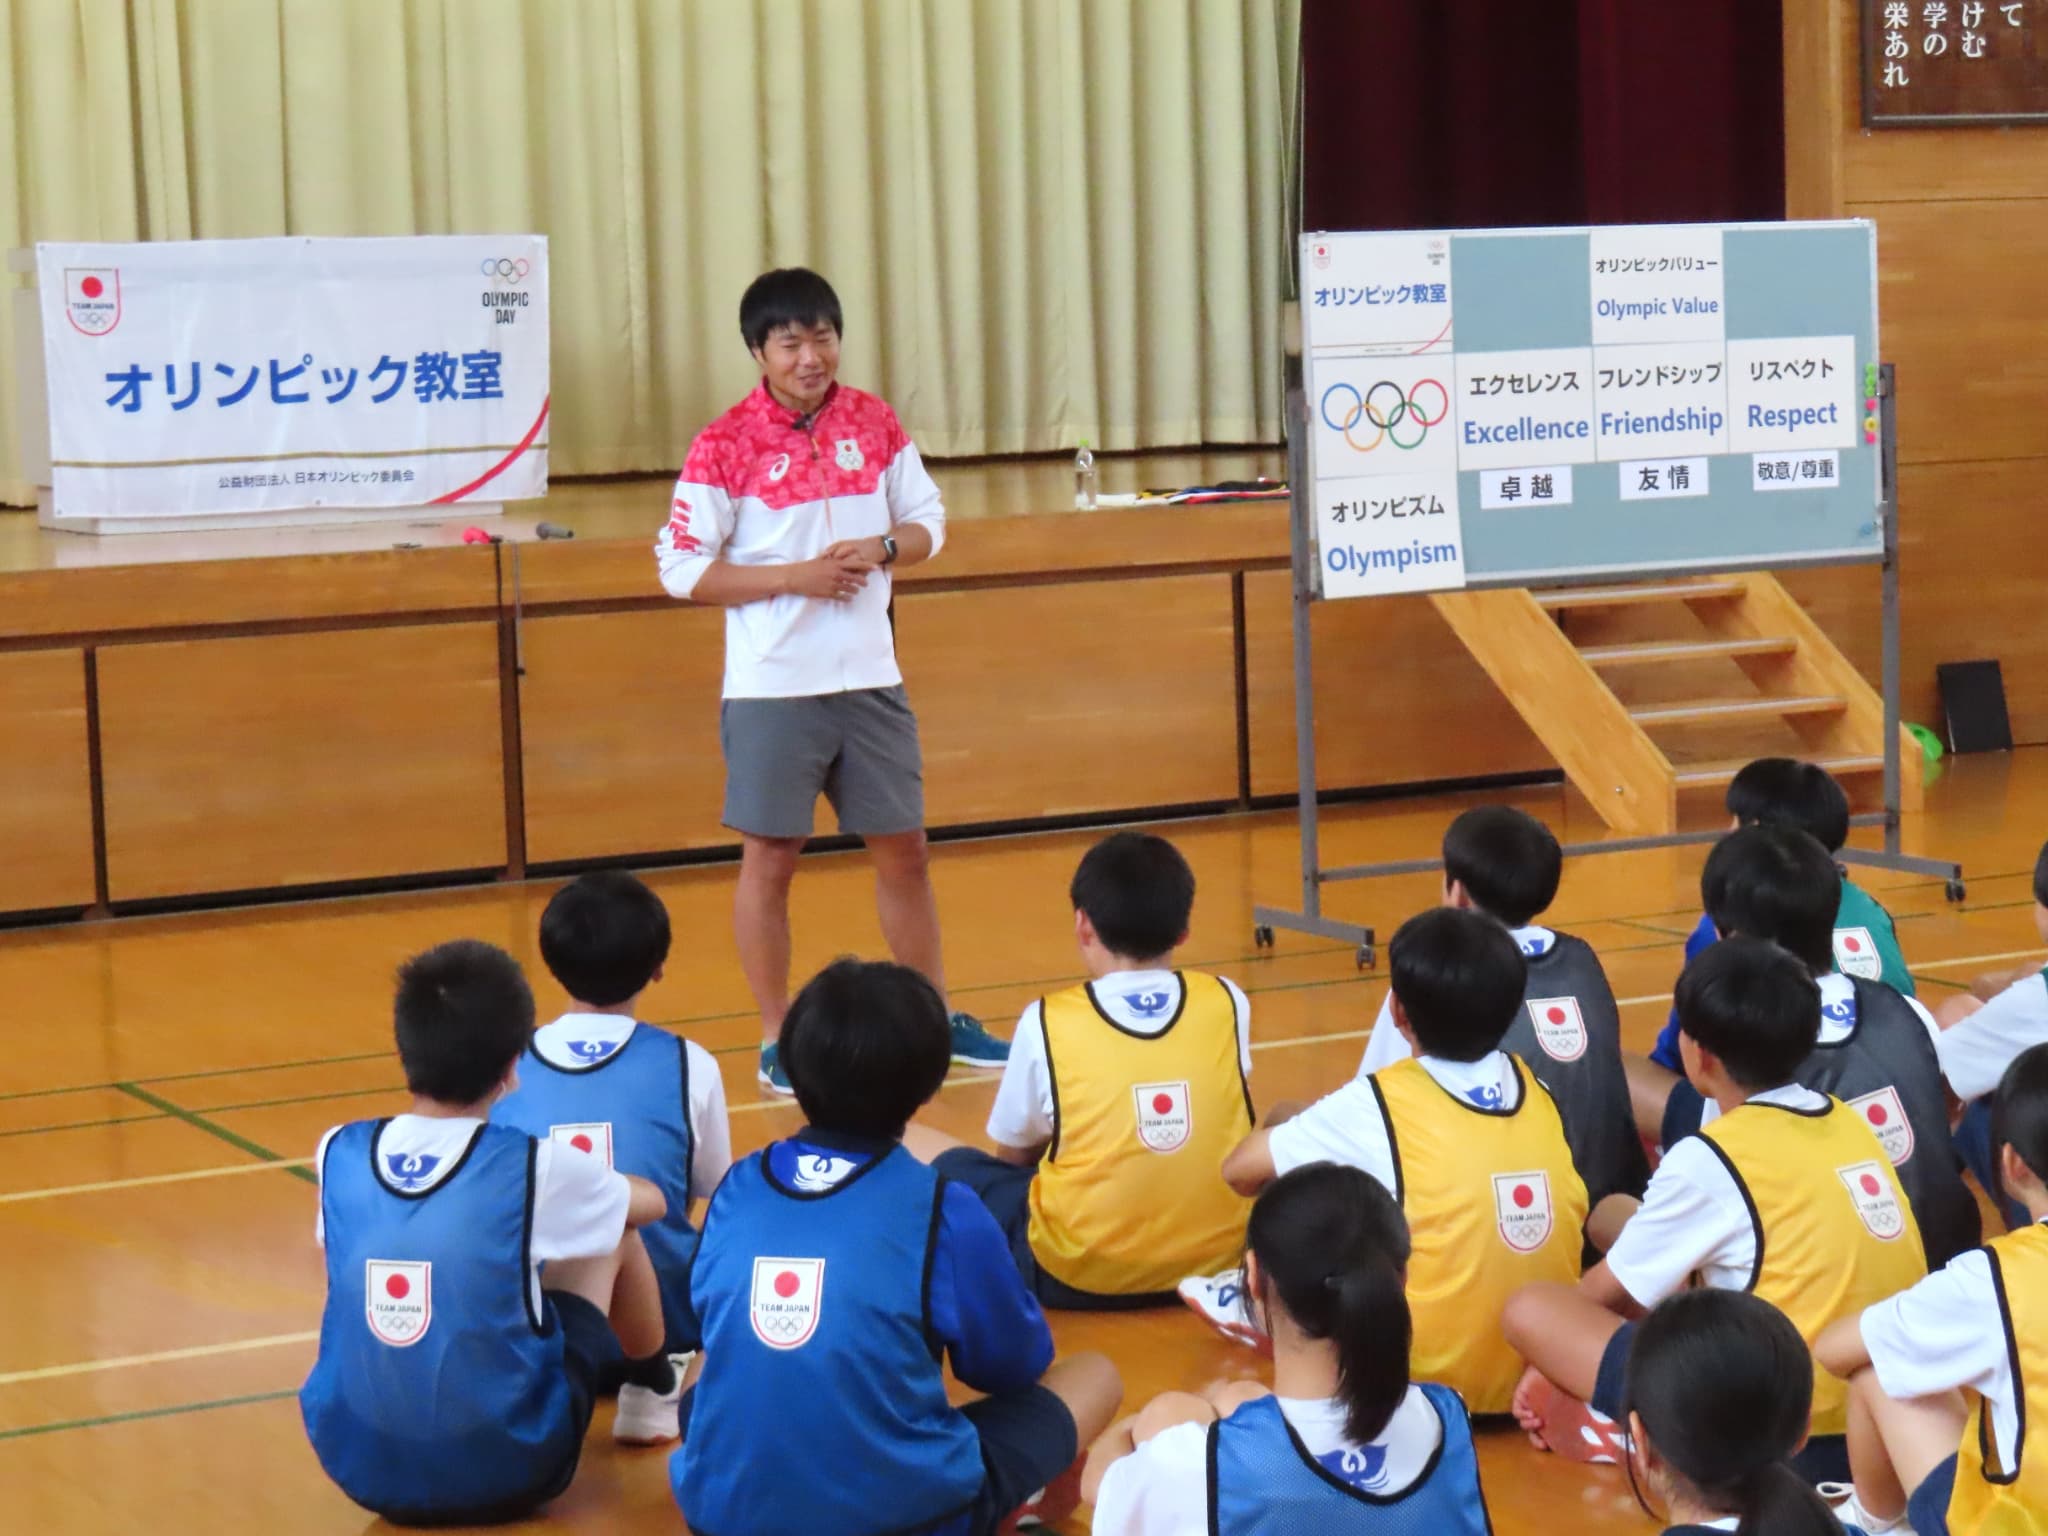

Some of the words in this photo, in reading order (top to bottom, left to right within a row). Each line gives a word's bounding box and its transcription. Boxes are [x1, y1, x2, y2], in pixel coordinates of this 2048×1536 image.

[1923, 1, 1947, 55] 学の
[1883, 2, 1909, 87] 栄あれ
[1595, 257, 1718, 273] オリンピックバリュー
[482, 291, 529, 307] OLYMPIC
[1314, 284, 1447, 306] オリンピック教室
[495, 309, 516, 324] DAY
[1597, 298, 1667, 320] Olympic
[1672, 297, 1719, 314] Value
[105, 350, 504, 412] オリンピック教室
[1598, 362, 1722, 389] フレンドシップ
[1750, 359, 1834, 381] リスペクト
[1470, 372, 1579, 395] エクセレンス
[1601, 406, 1723, 436] Friendship
[1748, 402, 1838, 432] Respect
[1464, 416, 1589, 444] Excellence
[1757, 459, 1834, 482] 敬意/尊重
[1332, 495, 1445, 523] オリンピズム
[1327, 539, 1457, 576] Olympism
[1144, 1119, 1162, 1127] TEAM
[1506, 1214, 1524, 1222] TEAM
[375, 1304, 396, 1312] TEAM
[397, 1304, 422, 1313] JAPAN
[761, 1304, 783, 1312] TEAM
[785, 1304, 810, 1313] JAPAN
